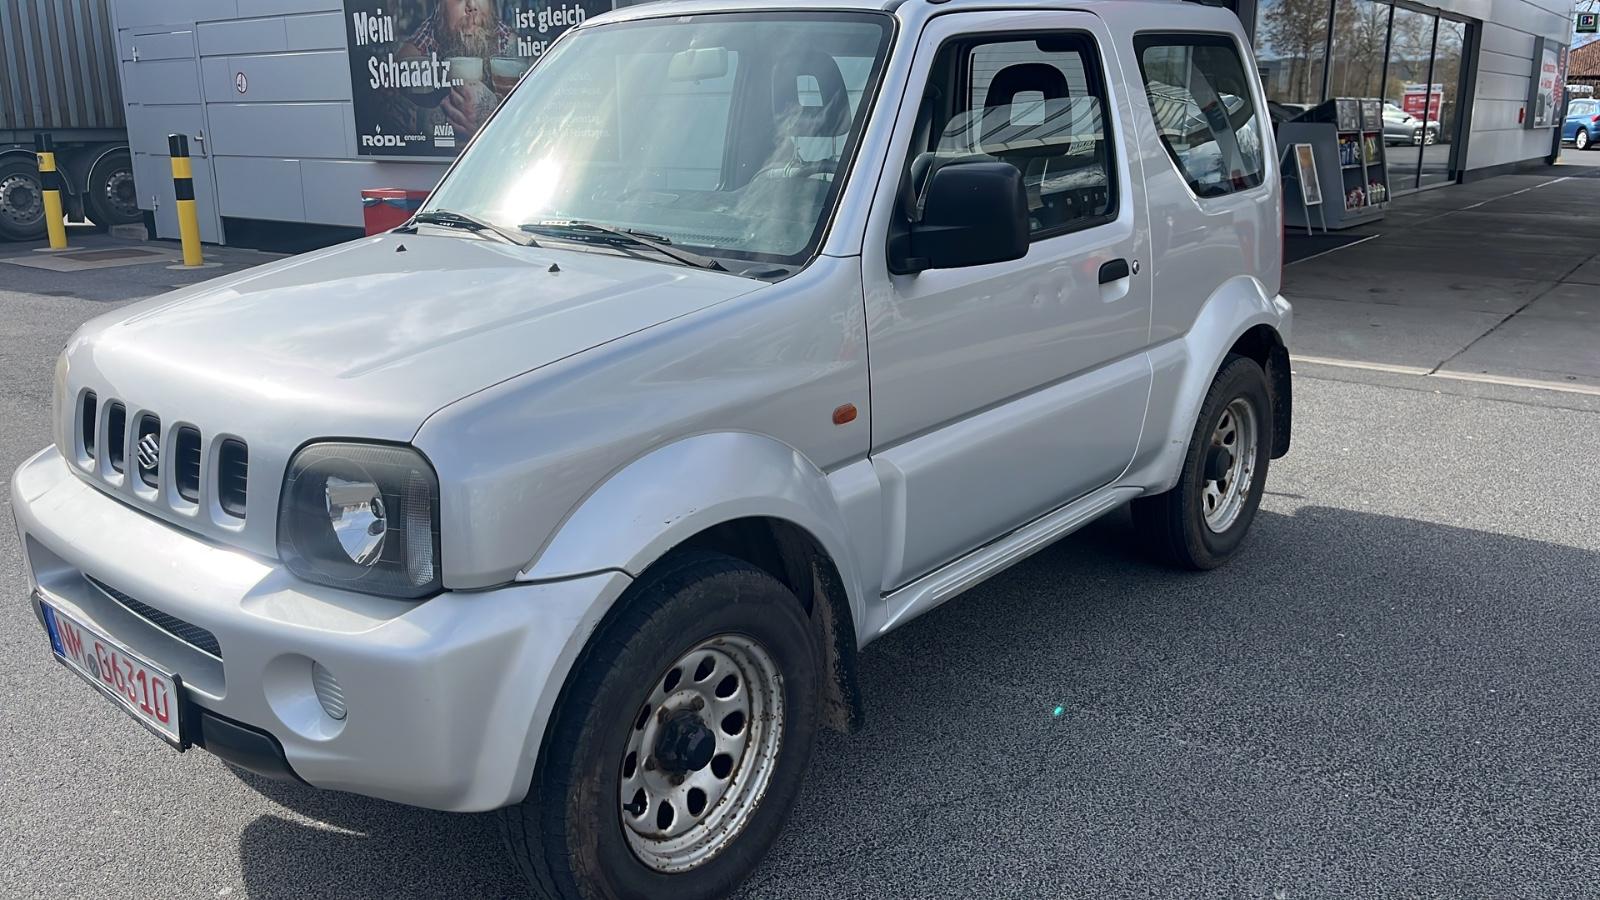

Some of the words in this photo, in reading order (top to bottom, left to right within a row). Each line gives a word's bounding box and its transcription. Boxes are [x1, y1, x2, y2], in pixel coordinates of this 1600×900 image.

[353, 8, 394, 46] Mein
[515, 7, 536, 28] ist
[538, 4, 586, 33] gleich
[517, 36, 548, 57] hier
[368, 52, 464, 90] Schaaatz...
[404, 132, 427, 141] energie
[56, 615, 89, 670] NM
